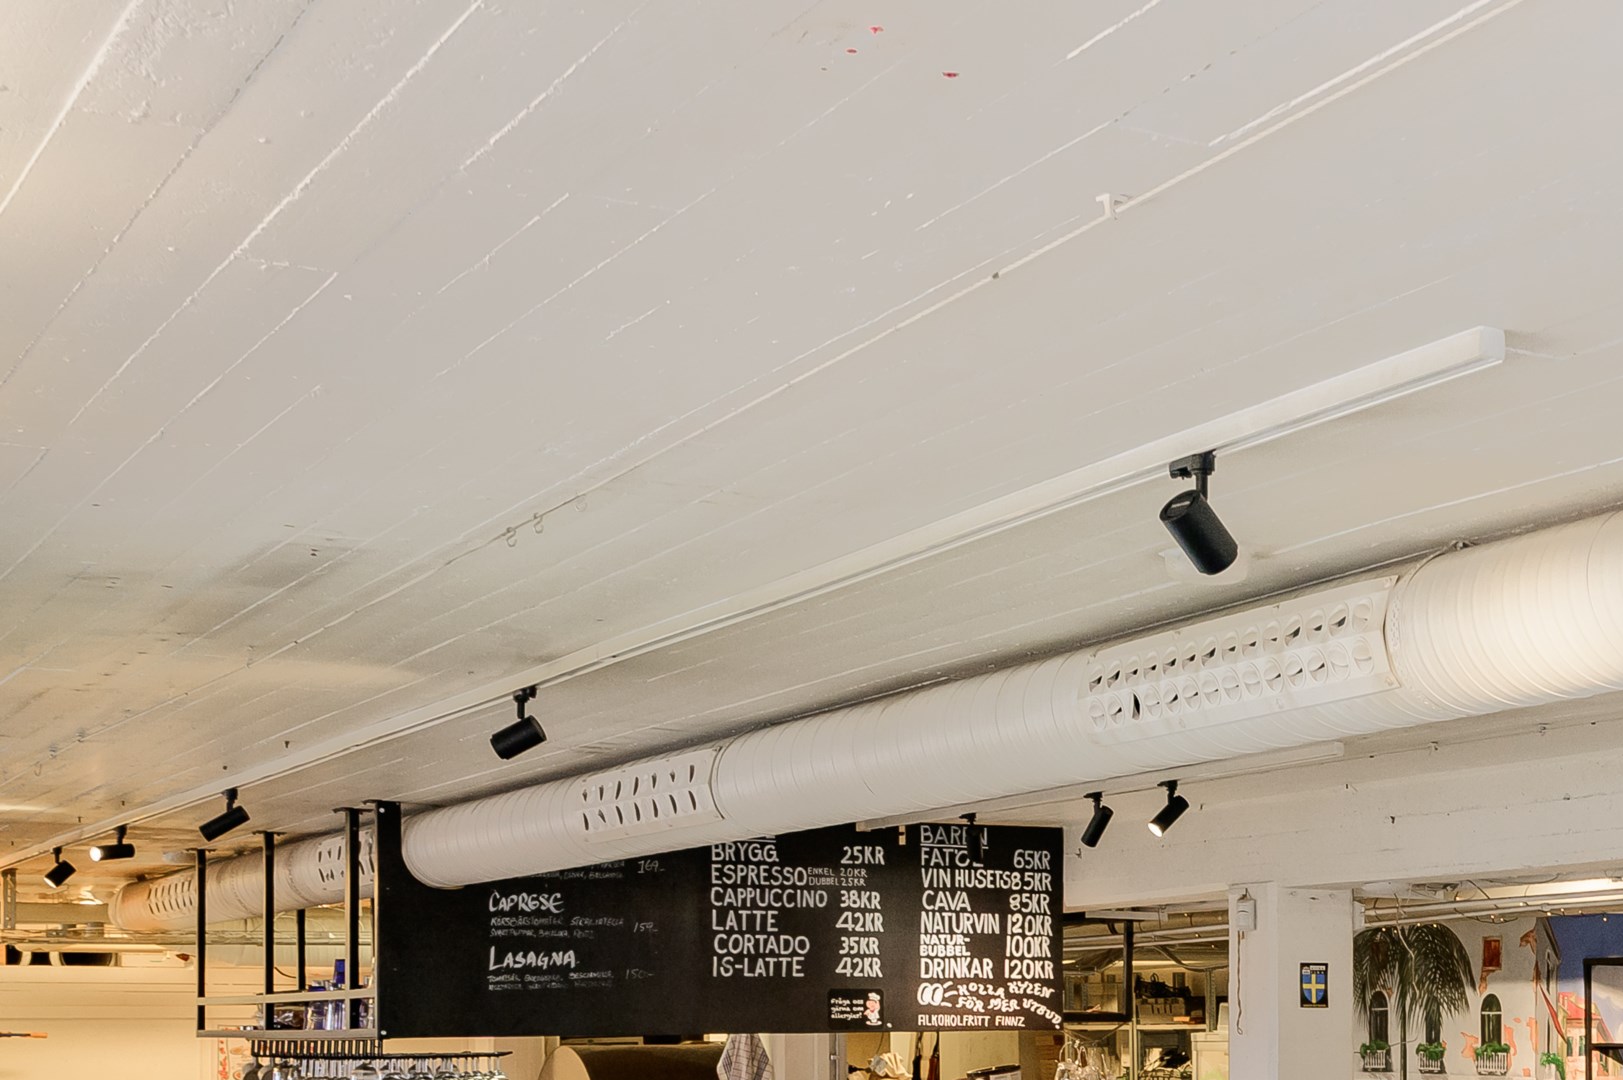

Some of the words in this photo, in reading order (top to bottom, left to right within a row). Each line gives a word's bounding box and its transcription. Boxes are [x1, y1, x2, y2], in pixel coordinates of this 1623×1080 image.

[711, 843, 779, 862] BRYGG
[840, 846, 885, 865] 25KR
[1013, 849, 1050, 870] 65KR
[711, 864, 807, 886] ESPRESSO
[807, 867, 835, 876] ENKEL
[840, 867, 868, 878] 20KR
[809, 877, 839, 886] DUBBEL
[841, 878, 866, 887] 25KR
[921, 869, 950, 888] VIN
[955, 870, 1011, 889] HUSETS
[1011, 872, 1052, 891] 85KR
[710, 887, 828, 908] CAPPUCCINO
[840, 890, 881, 910] 38KR
[922, 890, 971, 911] CAVA
[1009, 893, 1051, 914] 85KR
[712, 909, 779, 932] LATTE
[835, 912, 884, 933] 42KR
[921, 911, 999, 934] NATURVIN
[1007, 913, 1053, 936] 120KR
[714, 934, 810, 955] CORTADO
[839, 936, 880, 955] 35KR
[920, 934, 970, 945] NATUR-
[1006, 936, 1051, 958] 100KR
[920, 945, 971, 957] BUBBEL
[712, 956, 805, 977] IS-LATTE
[835, 957, 883, 978] 42KR
[920, 958, 993, 979] DRINKAR
[1004, 959, 1054, 980] 120KR
[957, 982, 1005, 999] KOLLA
[1007, 981, 1055, 998] KYLEN
[830, 997, 851, 1006] Fråga
[955, 996, 985, 1012] FÖR
[987, 998, 1021, 1012] MER
[918, 1014, 991, 1027] ALKOHOLFRITT
[995, 1015, 1026, 1027] FINNZ
